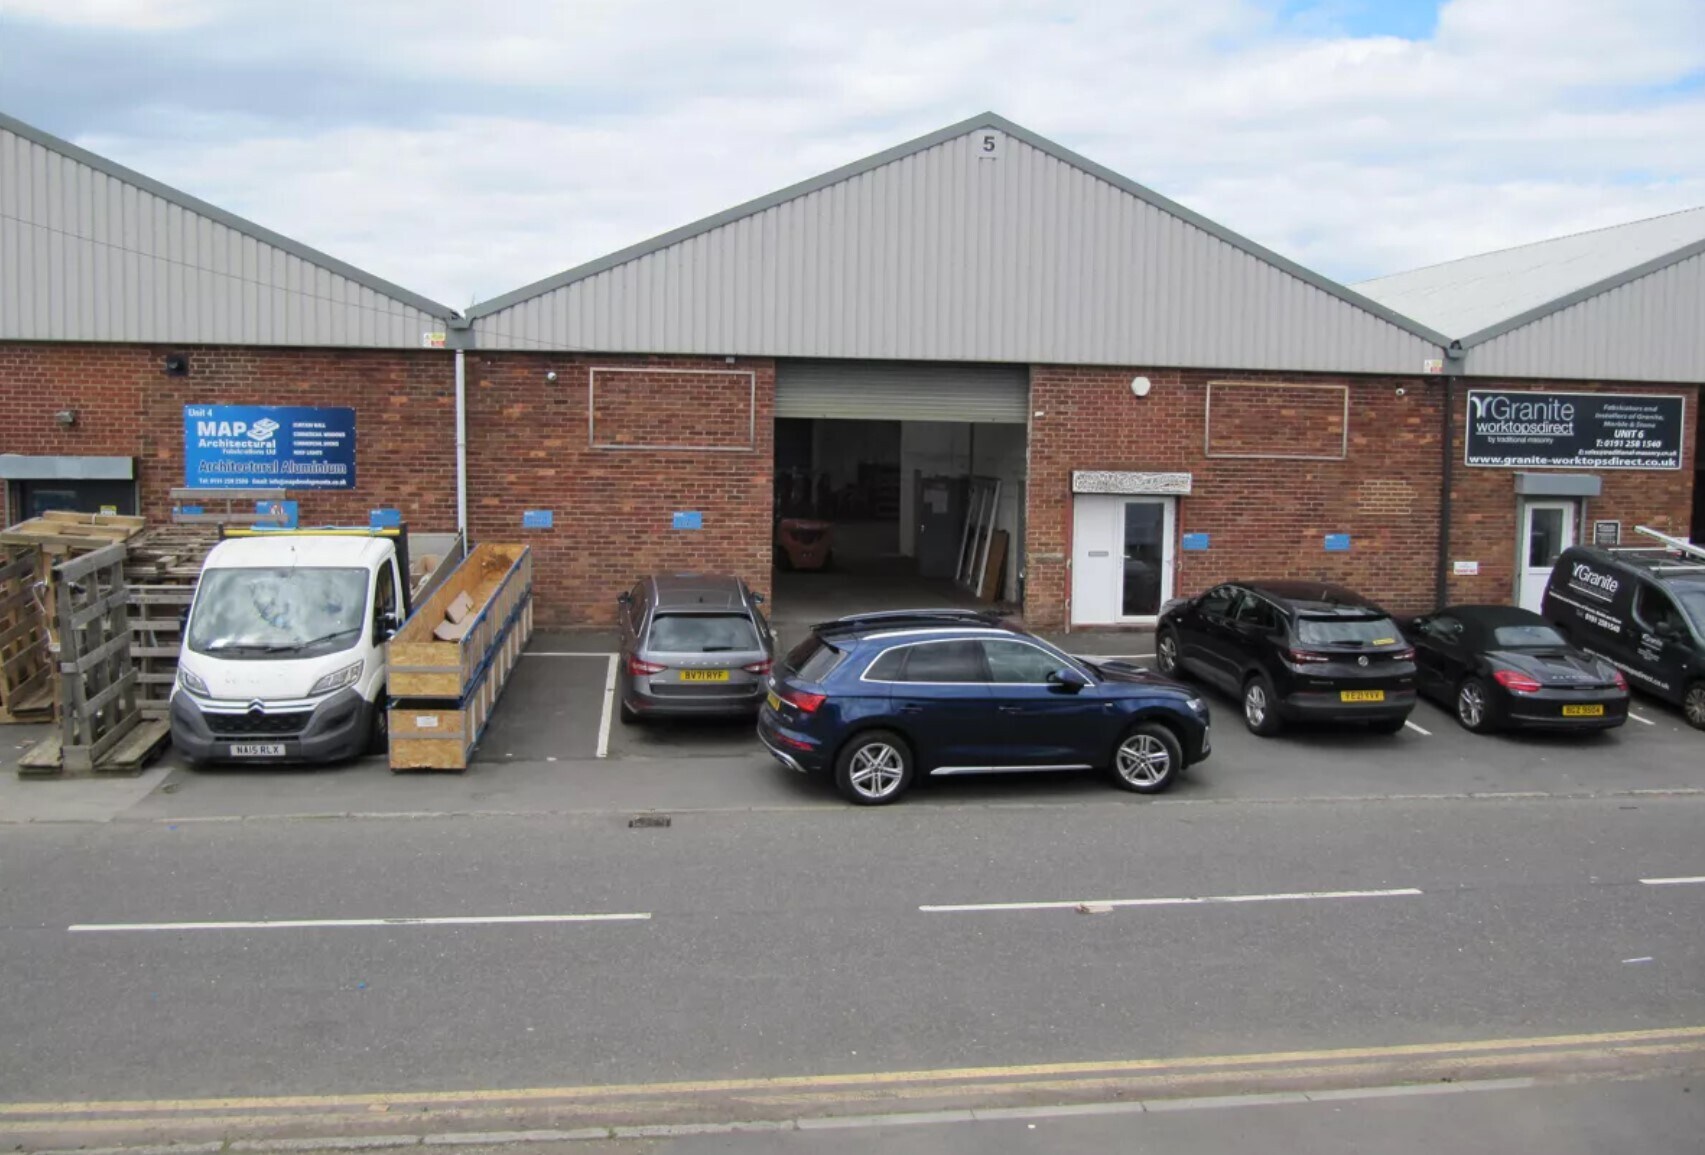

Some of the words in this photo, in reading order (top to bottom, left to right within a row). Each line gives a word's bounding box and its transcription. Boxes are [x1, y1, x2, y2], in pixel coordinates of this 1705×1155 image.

[983, 135, 995, 152] 5
[188, 409, 206, 417] Unit
[1491, 396, 1575, 421] Granite
[197, 421, 247, 437] MAP
[1476, 420, 1574, 434] worktopsdirect
[1614, 429, 1637, 438] UNIT
[1637, 430, 1645, 438] 6
[198, 439, 276, 448] Architectural
[199, 459, 278, 473] Architectural
[281, 460, 346, 475] Aluminium
[1469, 455, 1677, 467] www.granite-worktopsdirect.co.uk
[1579, 566, 1618, 592] Granite
